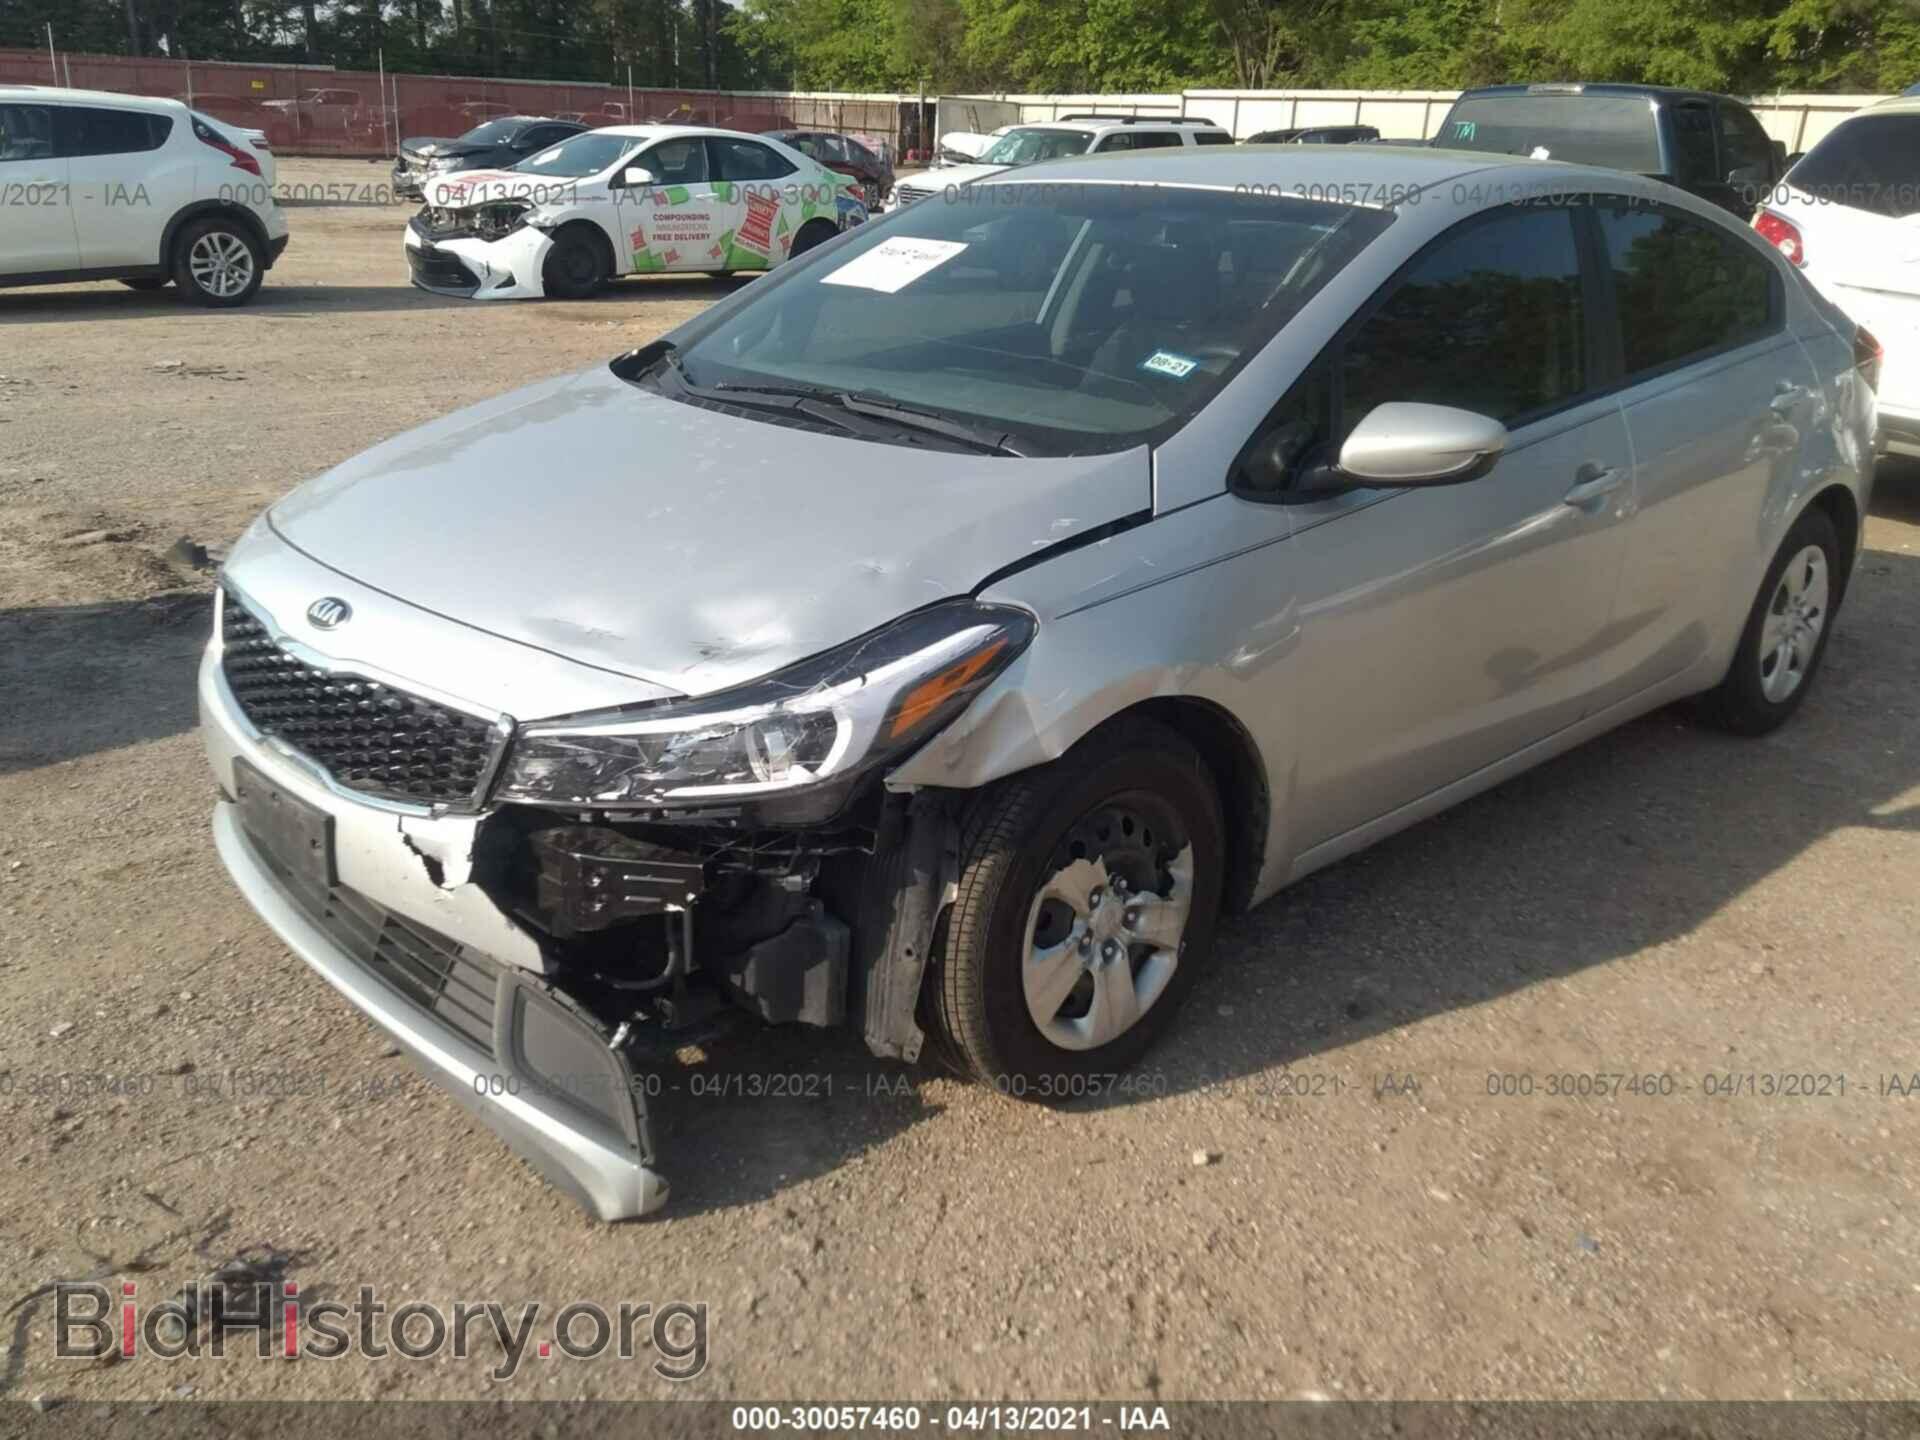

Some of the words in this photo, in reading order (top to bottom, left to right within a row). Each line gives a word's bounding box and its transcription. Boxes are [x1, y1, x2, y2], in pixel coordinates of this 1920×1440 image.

[652, 213, 710, 222] COMPOUNDING
[652, 233, 672, 241] FREE
[674, 233, 710, 241] DELIVERY
